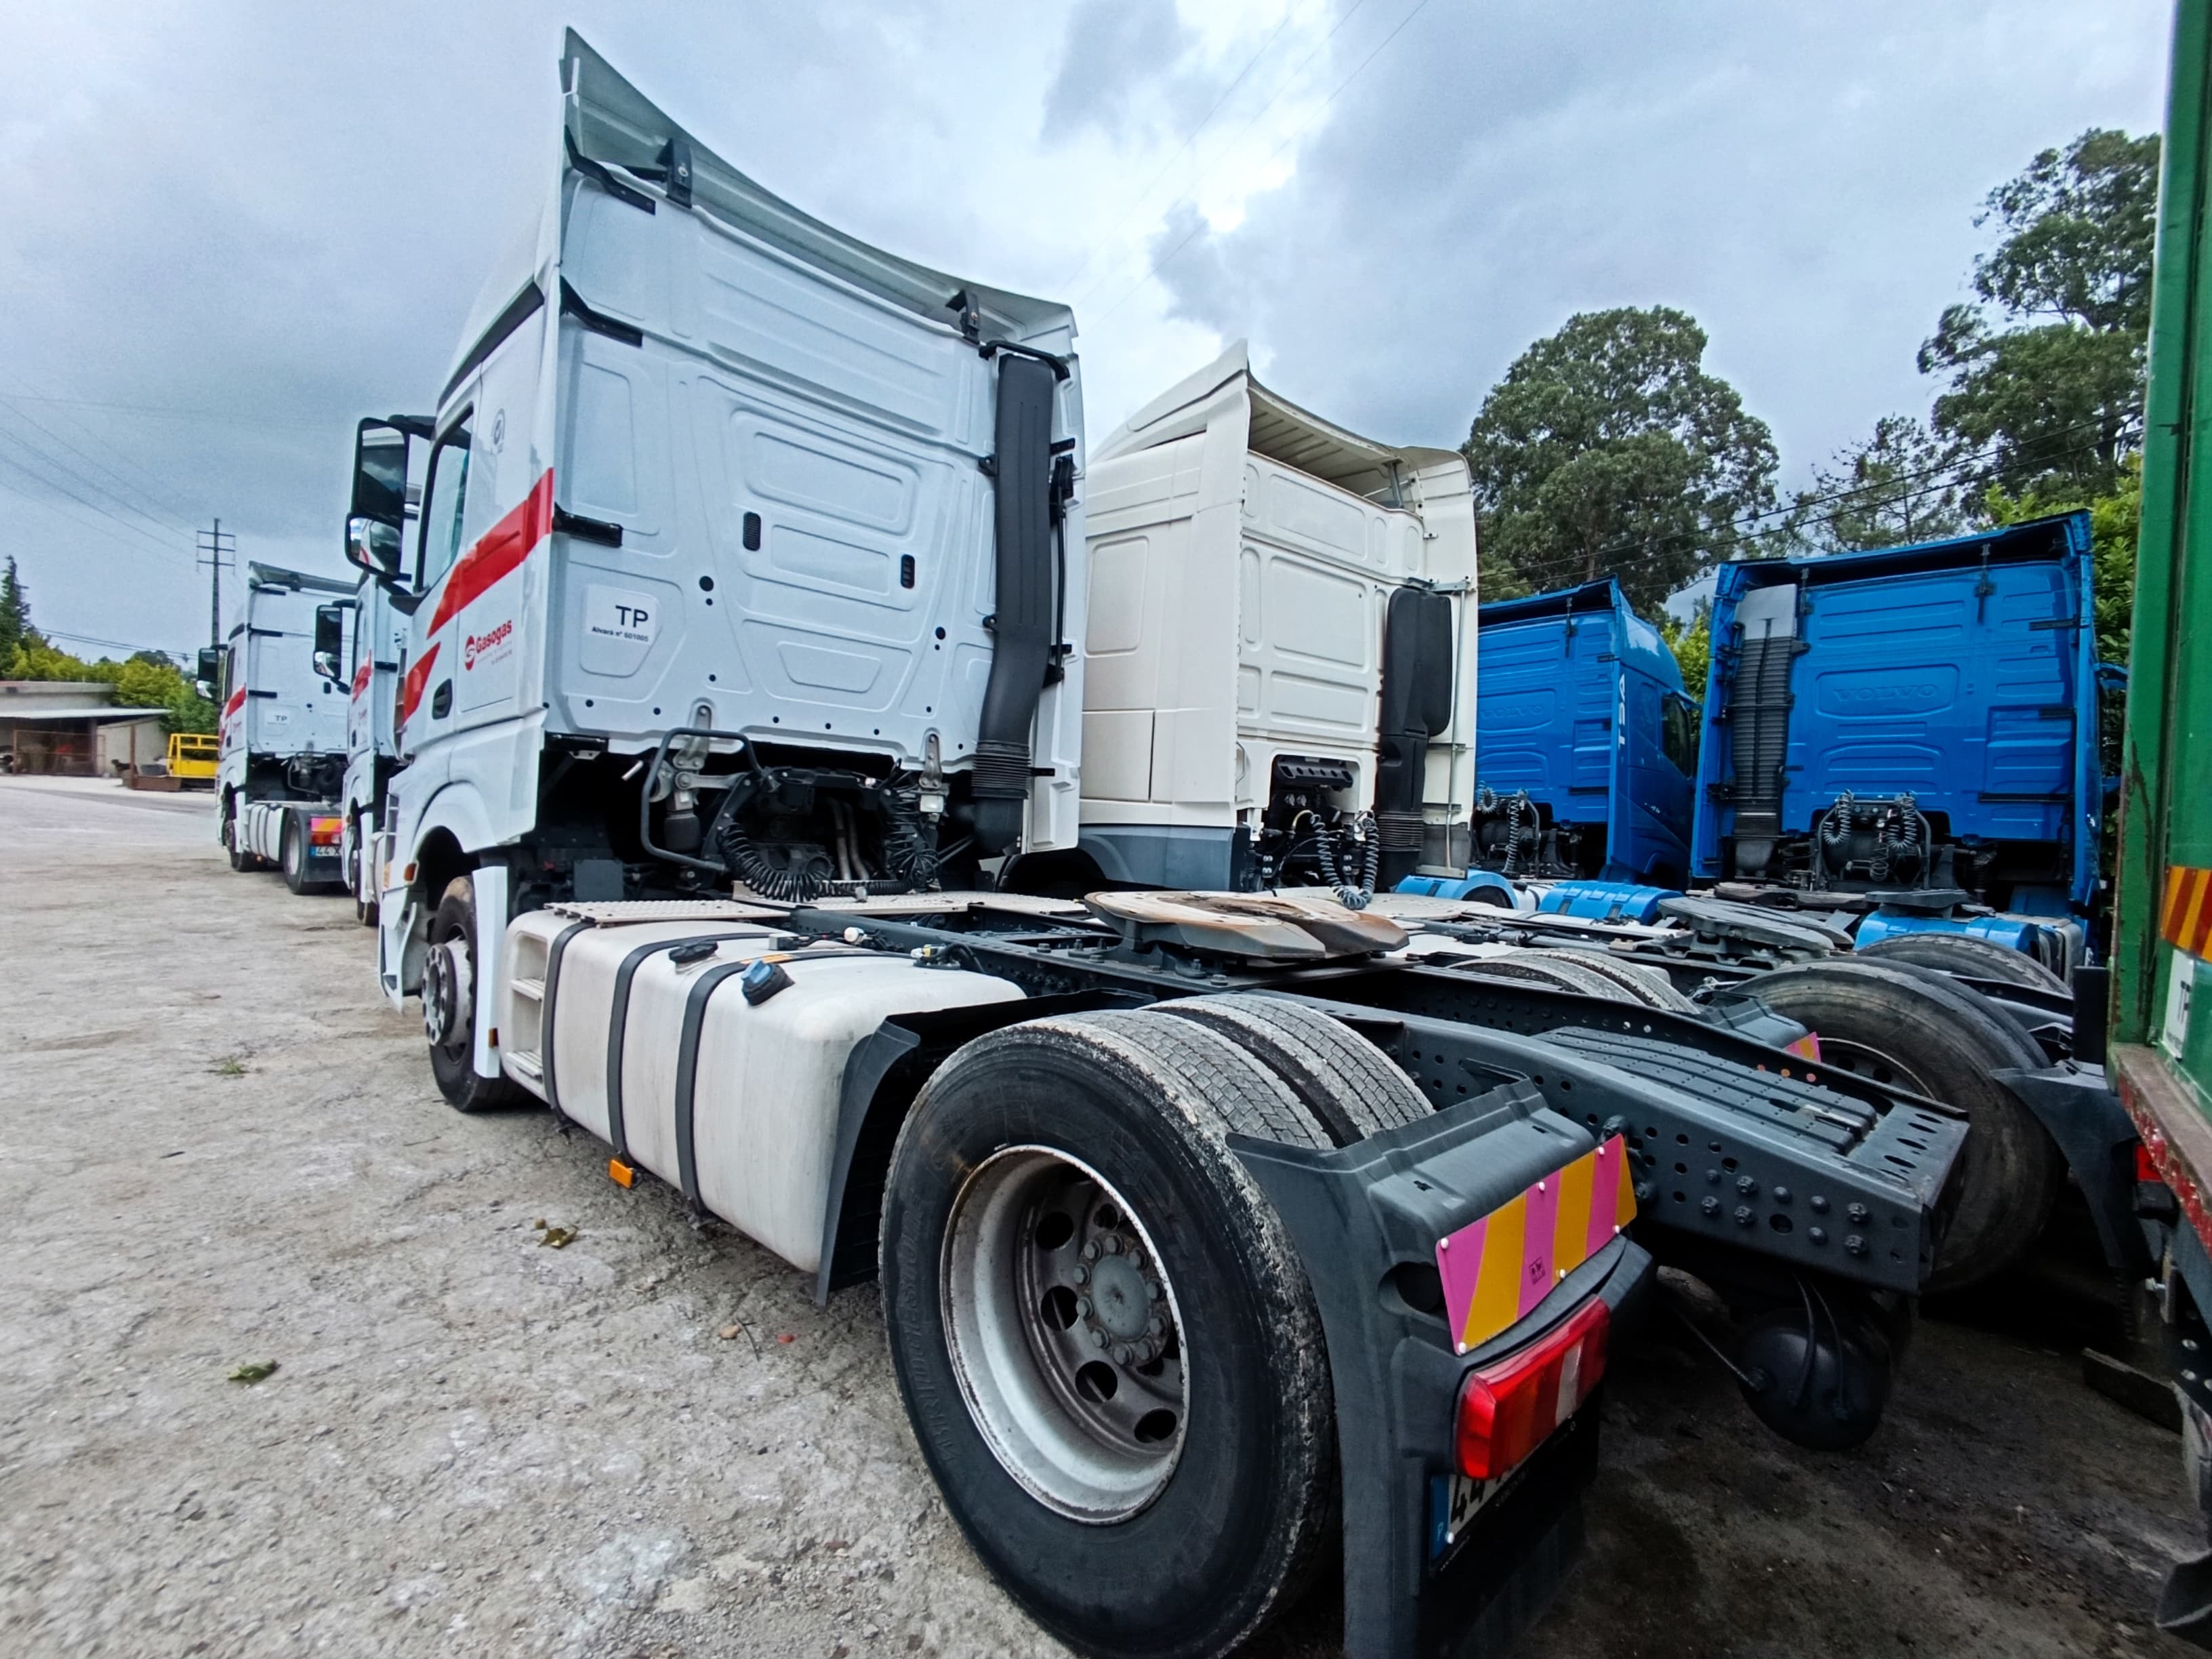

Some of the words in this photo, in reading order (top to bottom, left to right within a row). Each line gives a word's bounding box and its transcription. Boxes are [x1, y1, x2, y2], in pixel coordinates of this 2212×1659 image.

[615, 604, 649, 628] TP
[476, 619, 512, 655] Gasogas
[1832, 683, 1940, 702] VOLVO
[1479, 704, 1544, 720] VOLVO
